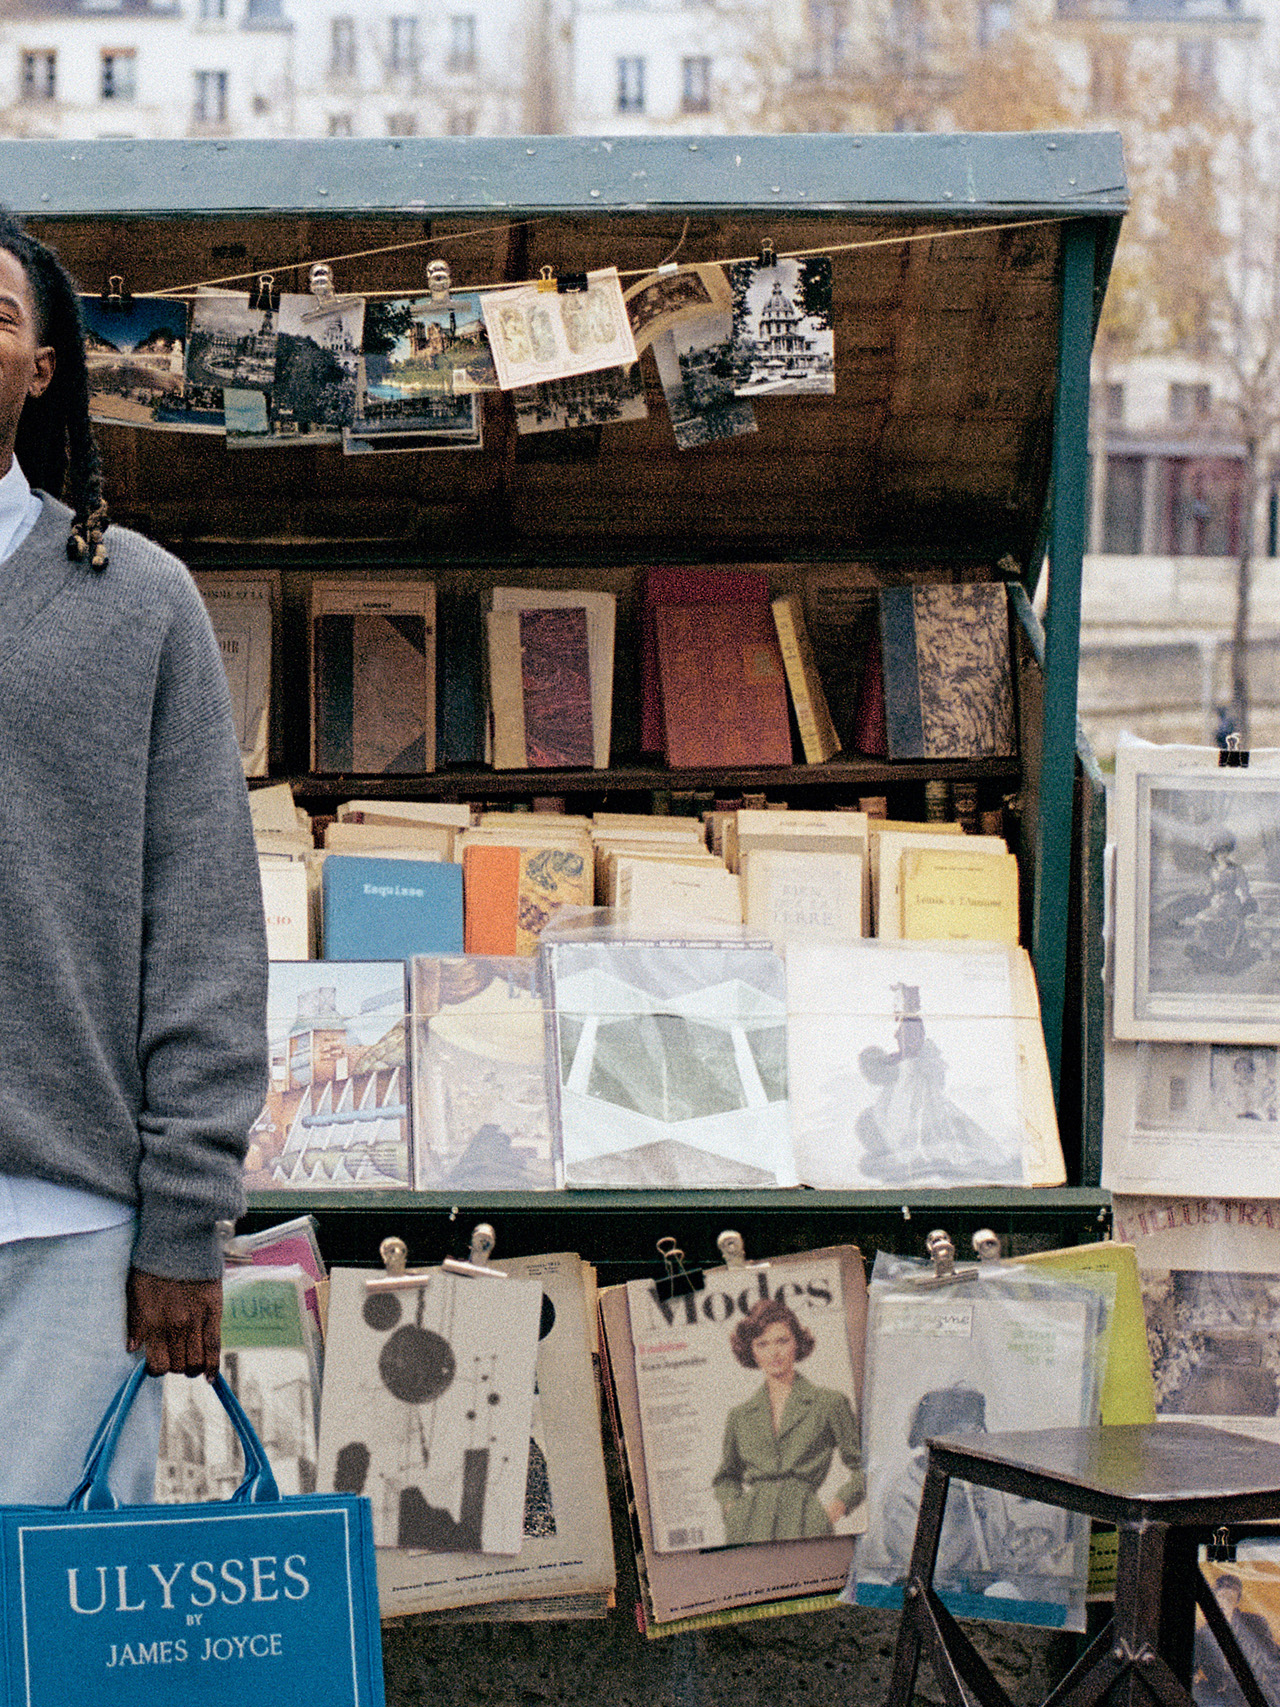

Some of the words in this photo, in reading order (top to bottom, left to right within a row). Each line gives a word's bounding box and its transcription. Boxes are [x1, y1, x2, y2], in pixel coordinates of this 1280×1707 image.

[362, 883, 425, 899] Esquisse
[1116, 1201, 1280, 1243] L'ILLUSTRA
[67, 1554, 310, 1615] ULYSSES
[186, 1613, 203, 1627] BY
[106, 1639, 189, 1668] JAMES
[200, 1634, 283, 1661] JOYCE
